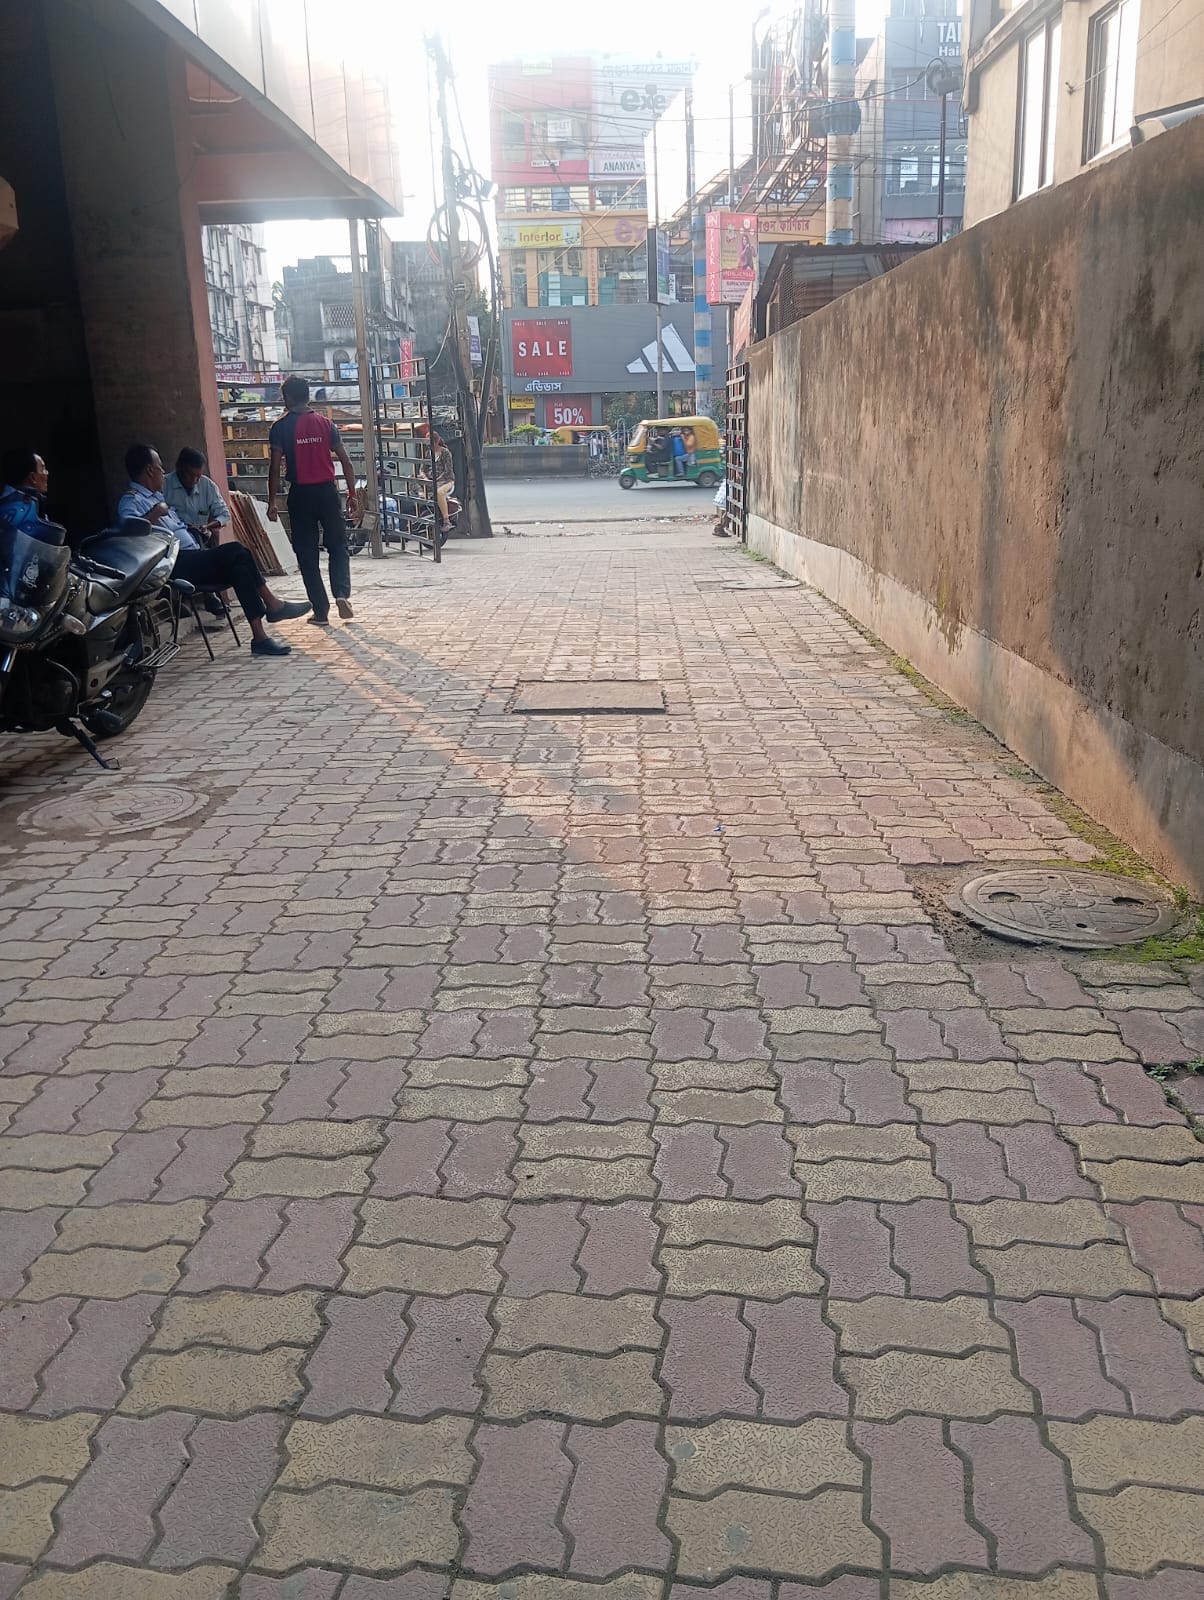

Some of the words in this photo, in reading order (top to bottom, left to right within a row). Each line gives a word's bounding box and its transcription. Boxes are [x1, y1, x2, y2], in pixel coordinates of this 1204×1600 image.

[603, 161, 636, 171] ANANYA
[518, 340, 567, 357] SALE
[554, 407, 584, 424] 50%
